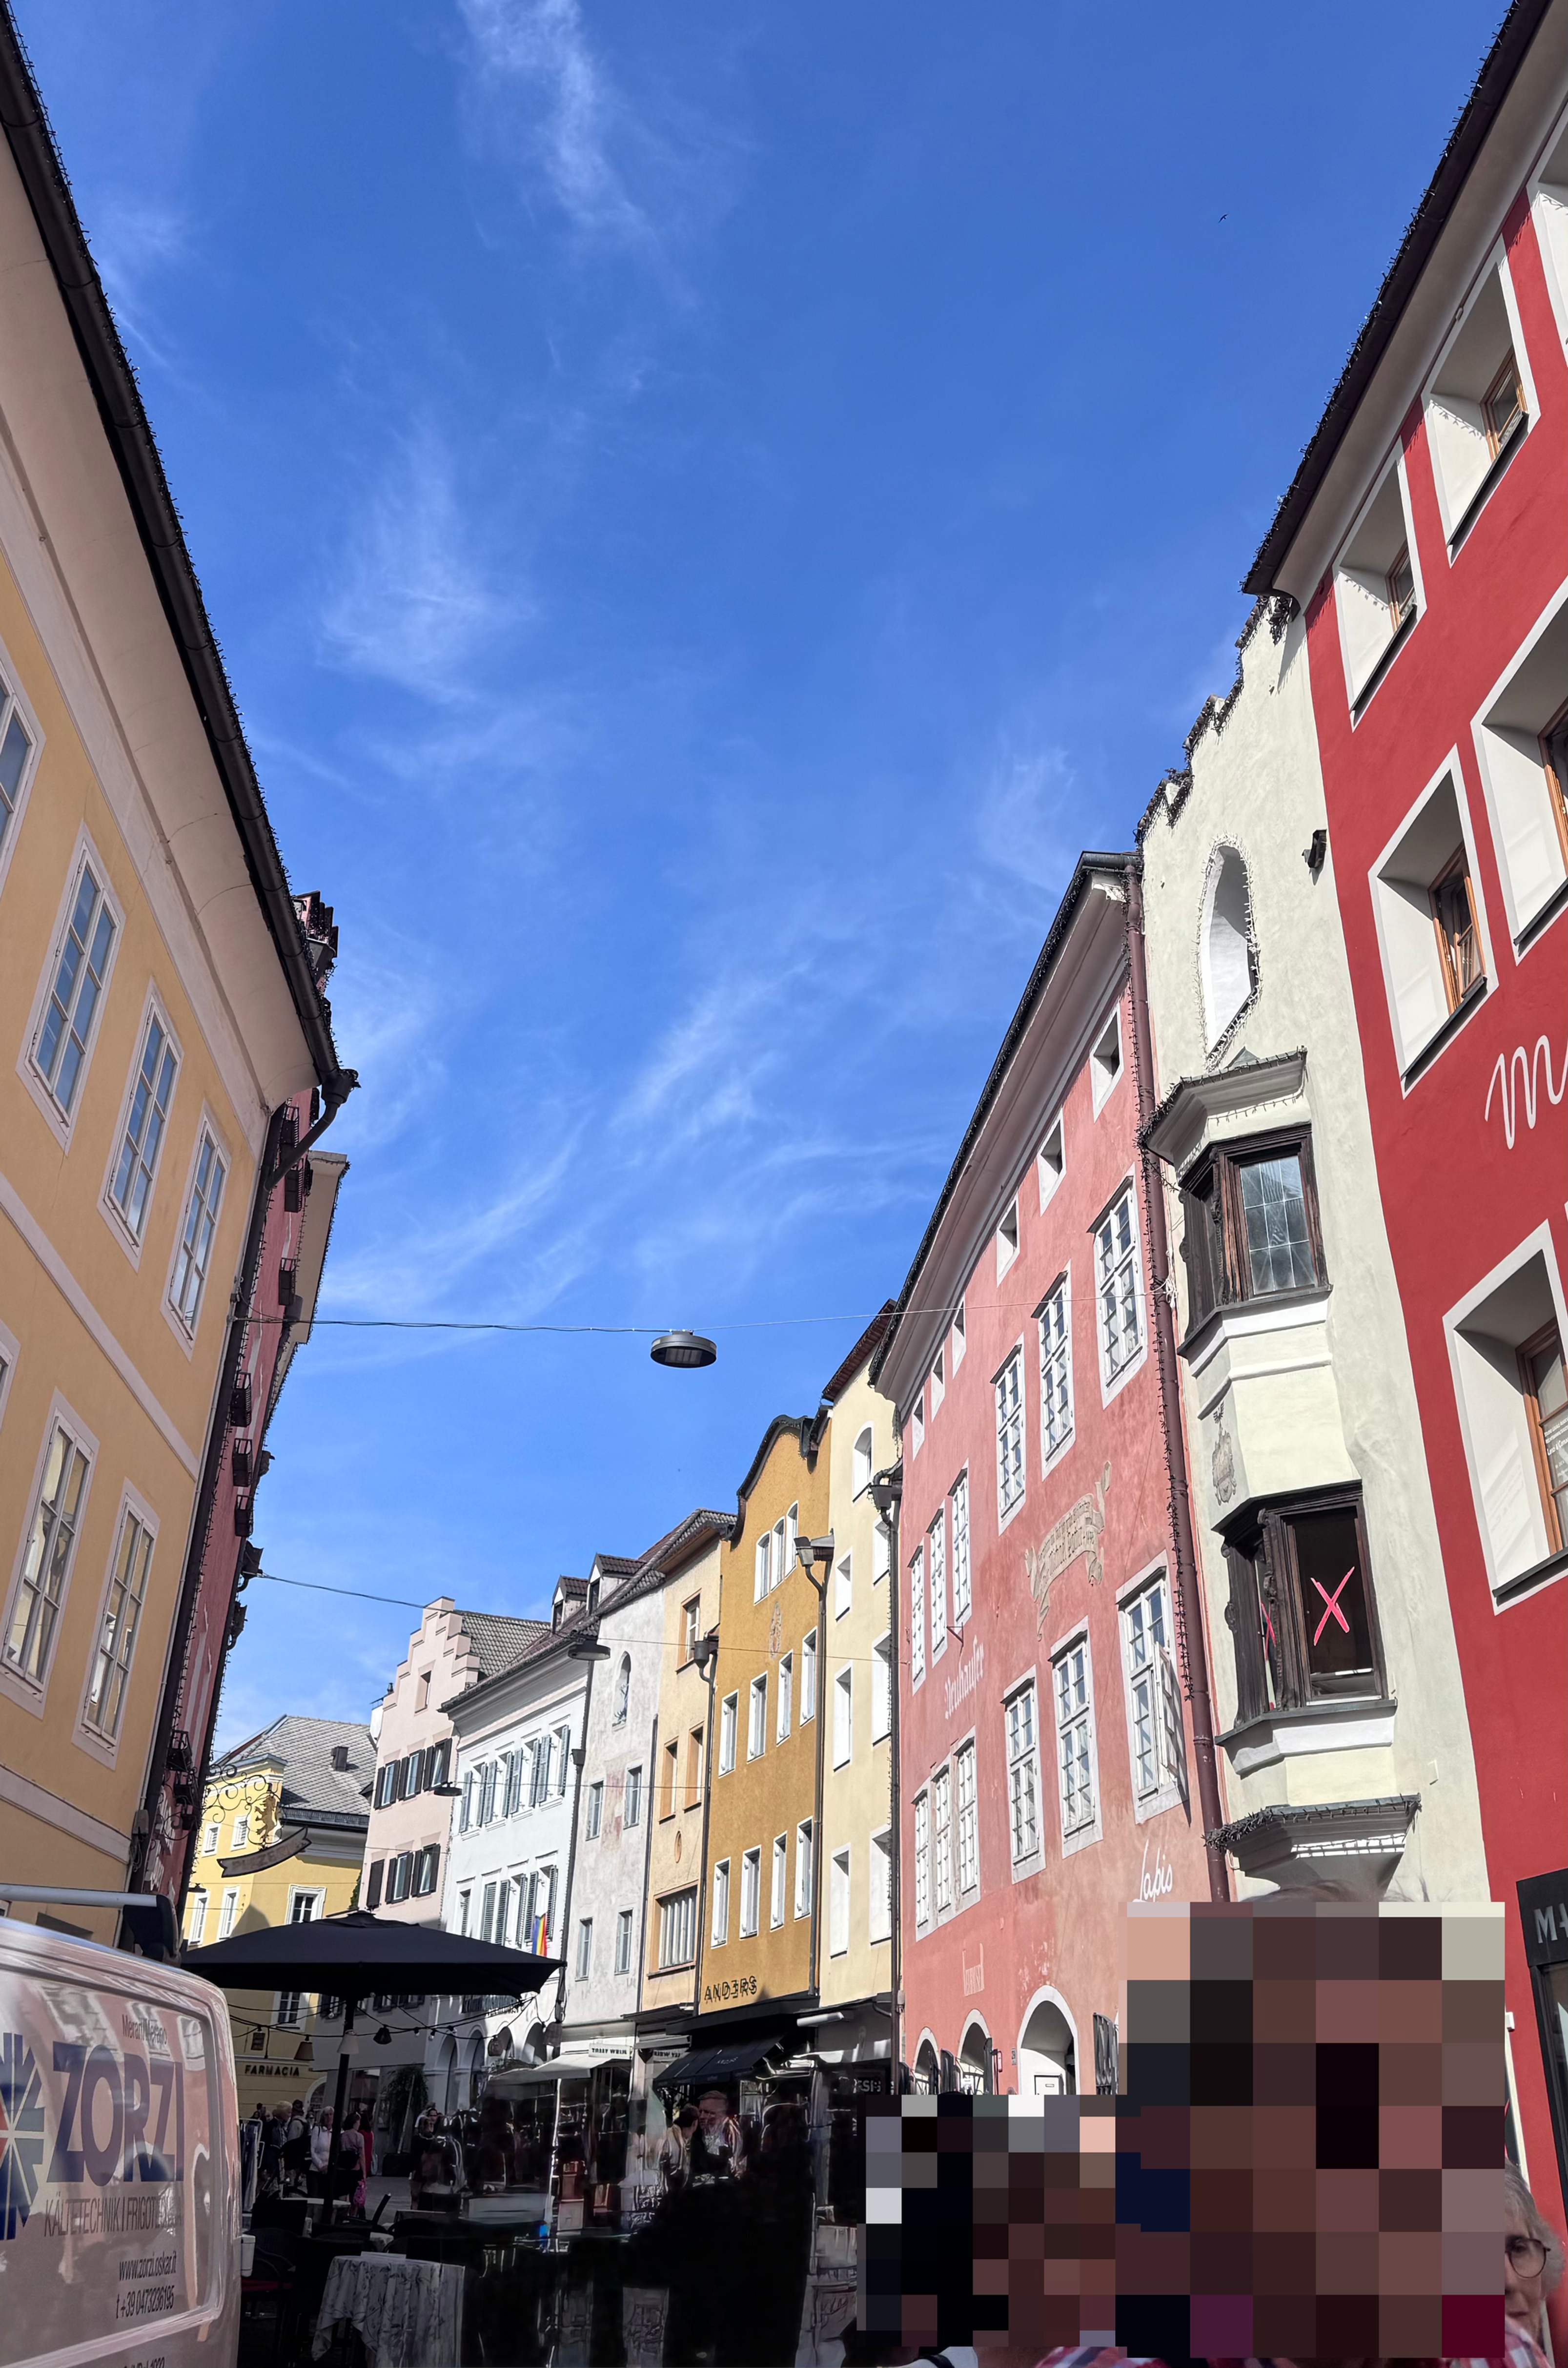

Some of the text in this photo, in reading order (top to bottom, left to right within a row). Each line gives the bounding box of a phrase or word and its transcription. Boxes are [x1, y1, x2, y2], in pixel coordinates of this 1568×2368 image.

[244, 2065, 300, 2076] FARMACIA
[46, 2041, 184, 2186] ZORZI
[44, 2191, 121, 2237] KÄLTETECHNIK
